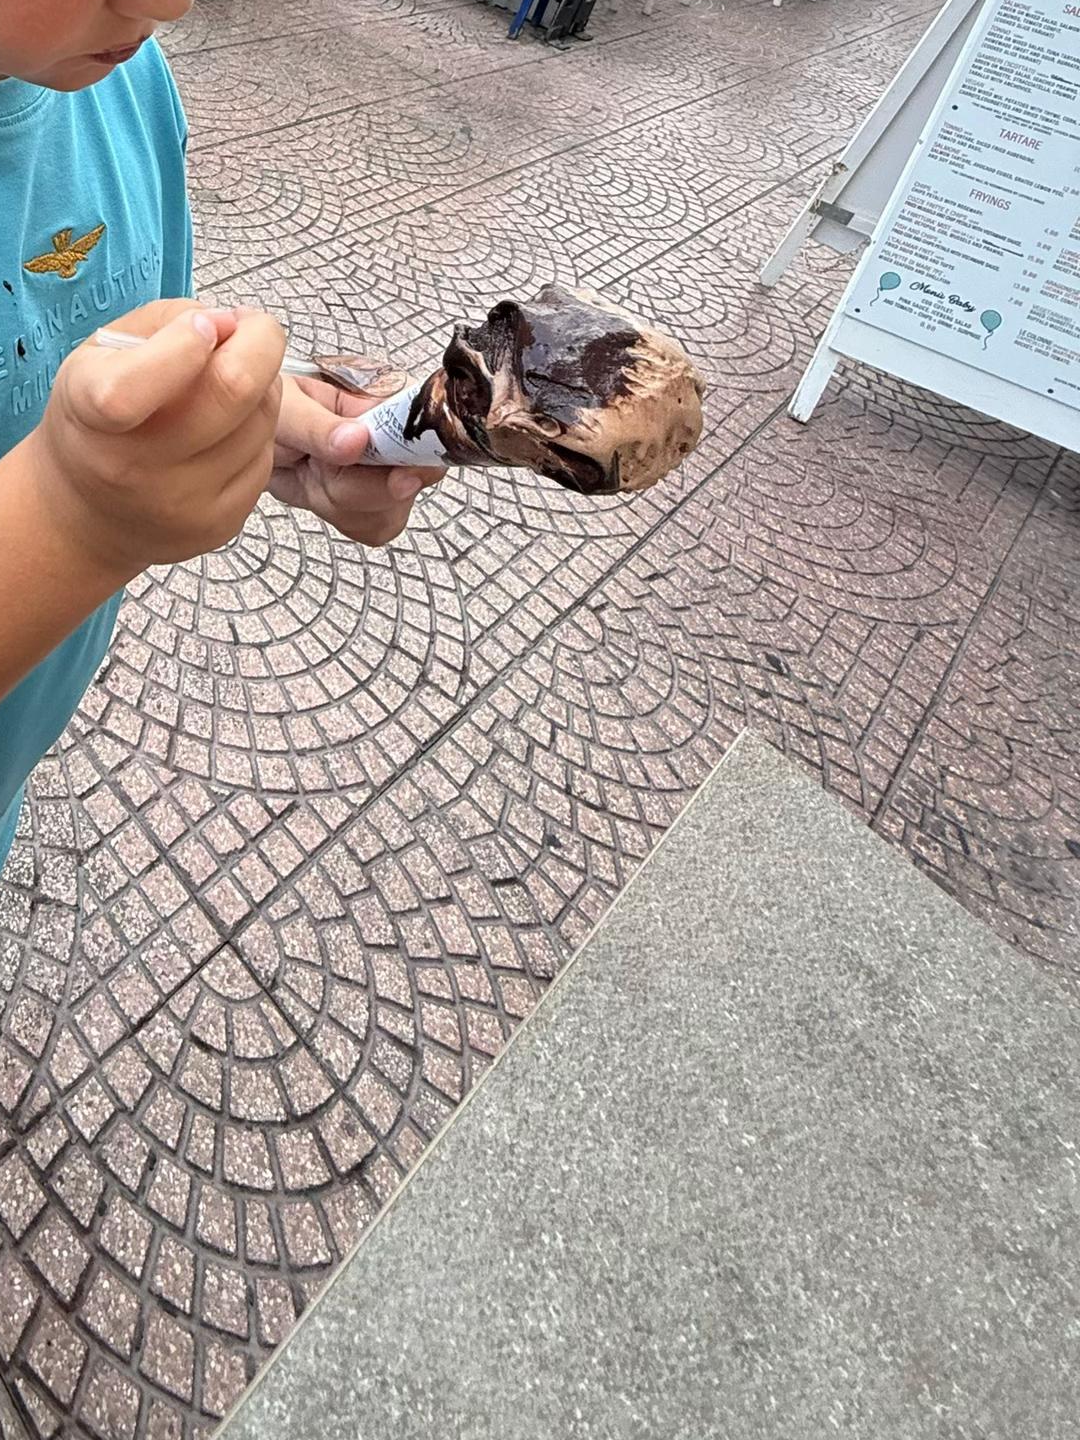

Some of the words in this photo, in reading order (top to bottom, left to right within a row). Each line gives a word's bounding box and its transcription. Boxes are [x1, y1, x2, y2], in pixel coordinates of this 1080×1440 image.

[998, 128, 1042, 150] TARTARE
[968, 188, 1011, 211] FRYINGS
[944, 292, 978, 314] Baby
